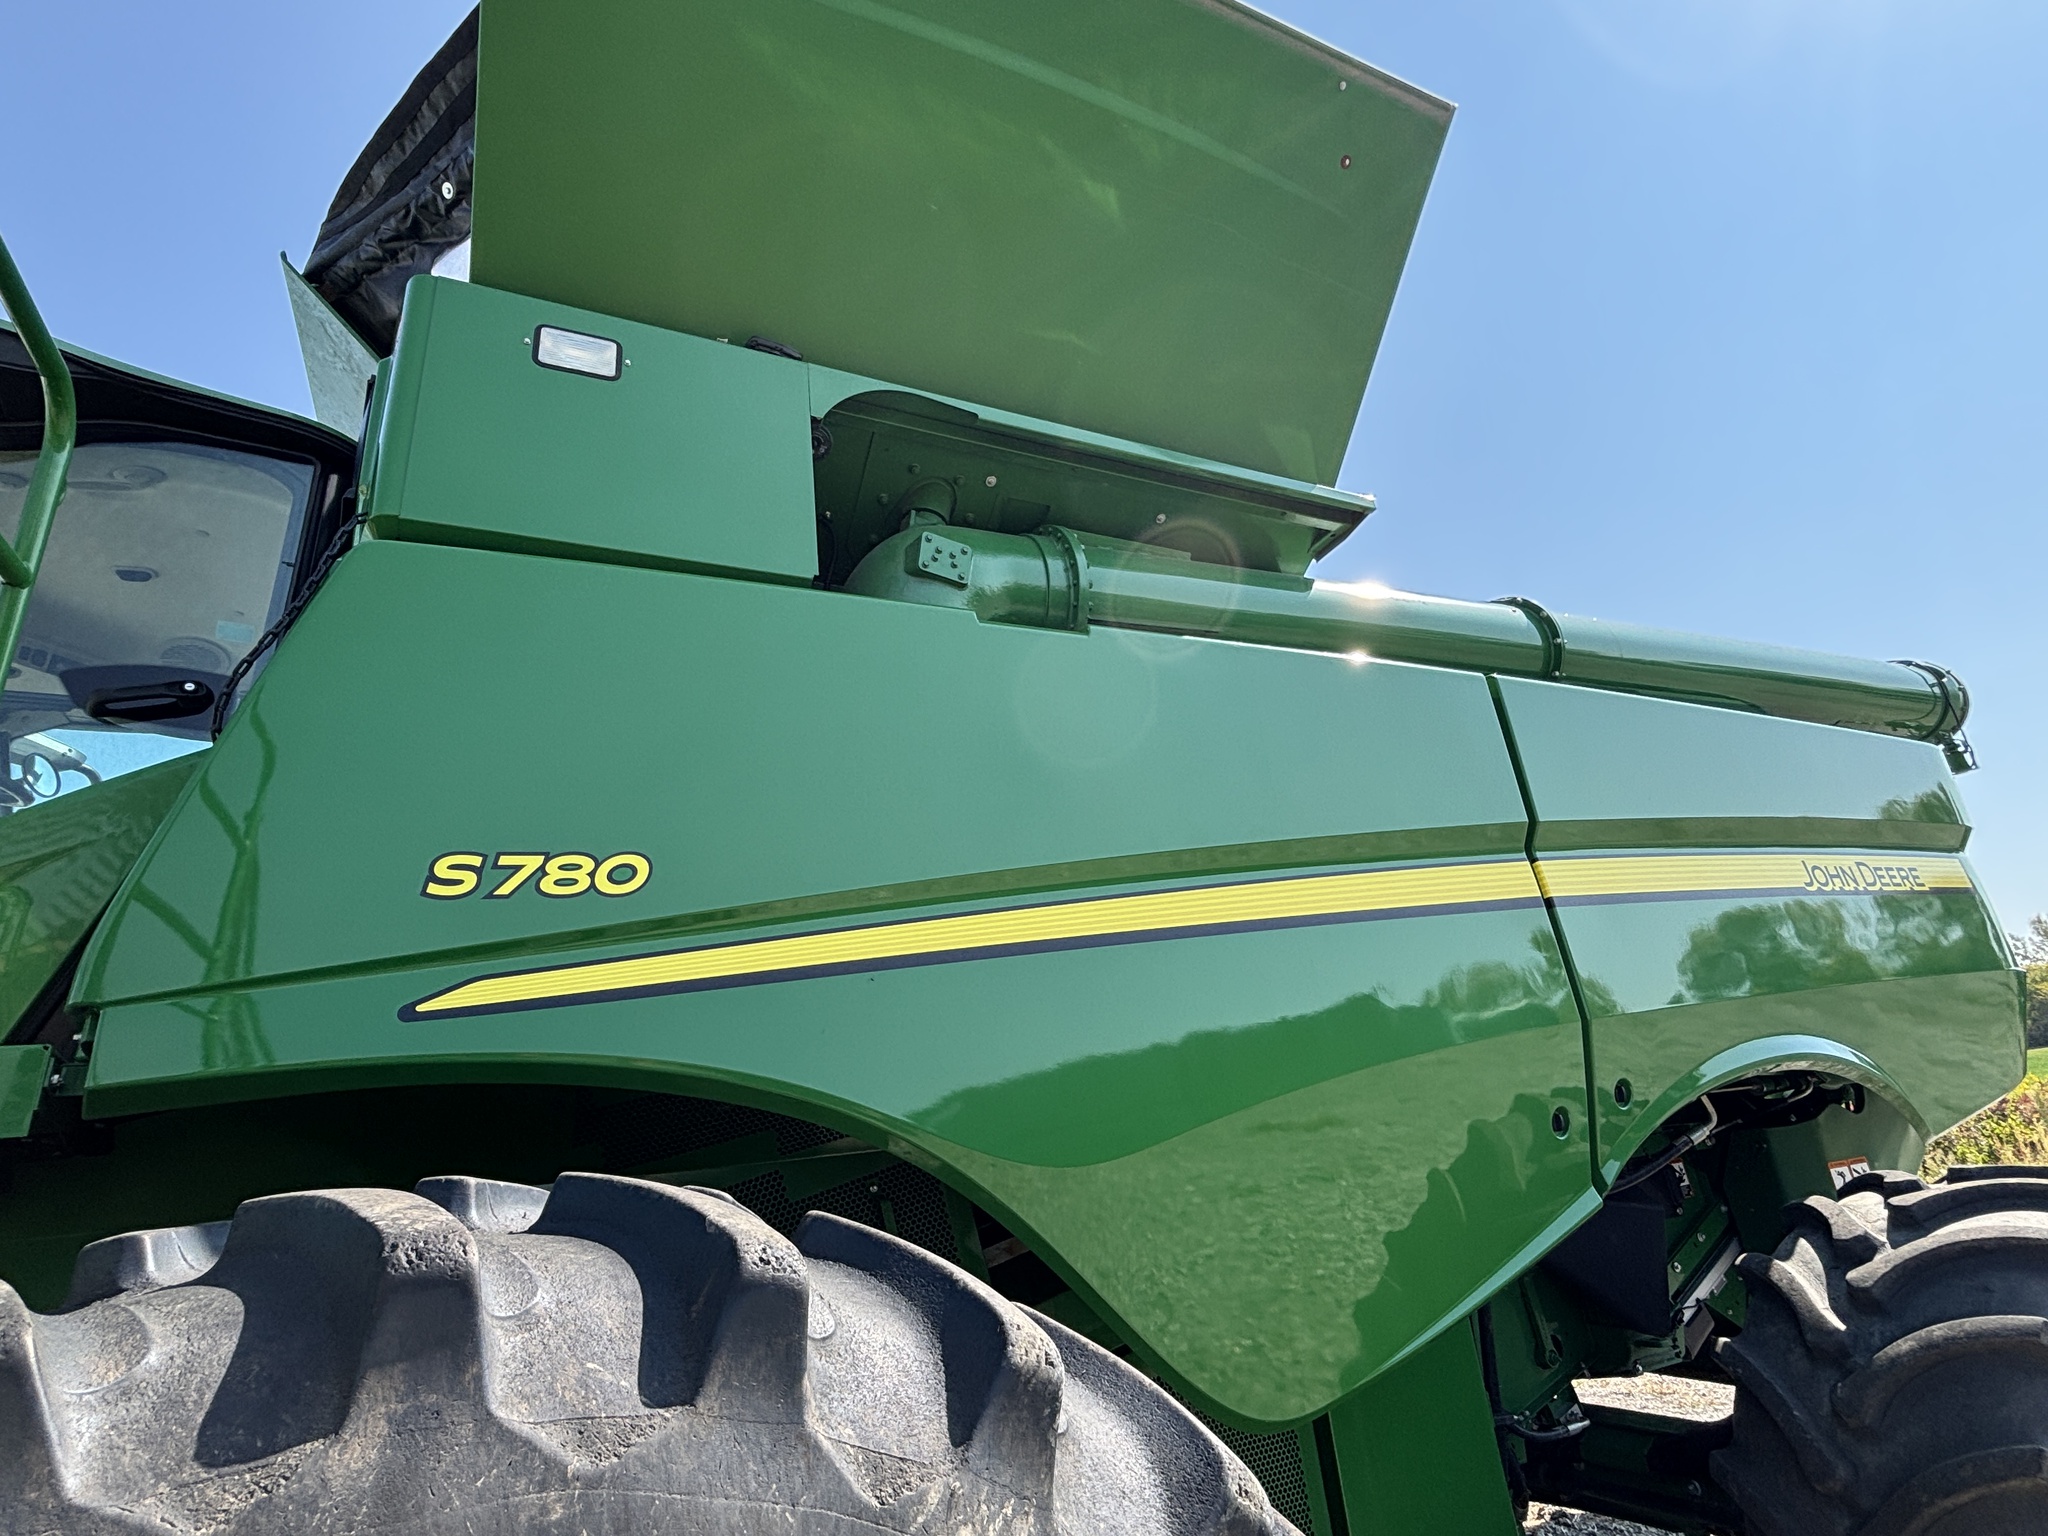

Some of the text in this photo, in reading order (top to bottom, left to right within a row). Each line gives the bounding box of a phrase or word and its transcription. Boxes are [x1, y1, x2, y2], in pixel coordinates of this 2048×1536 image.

[420, 851, 653, 900] S780
[1801, 860, 1926, 888] JOHN DEERE
